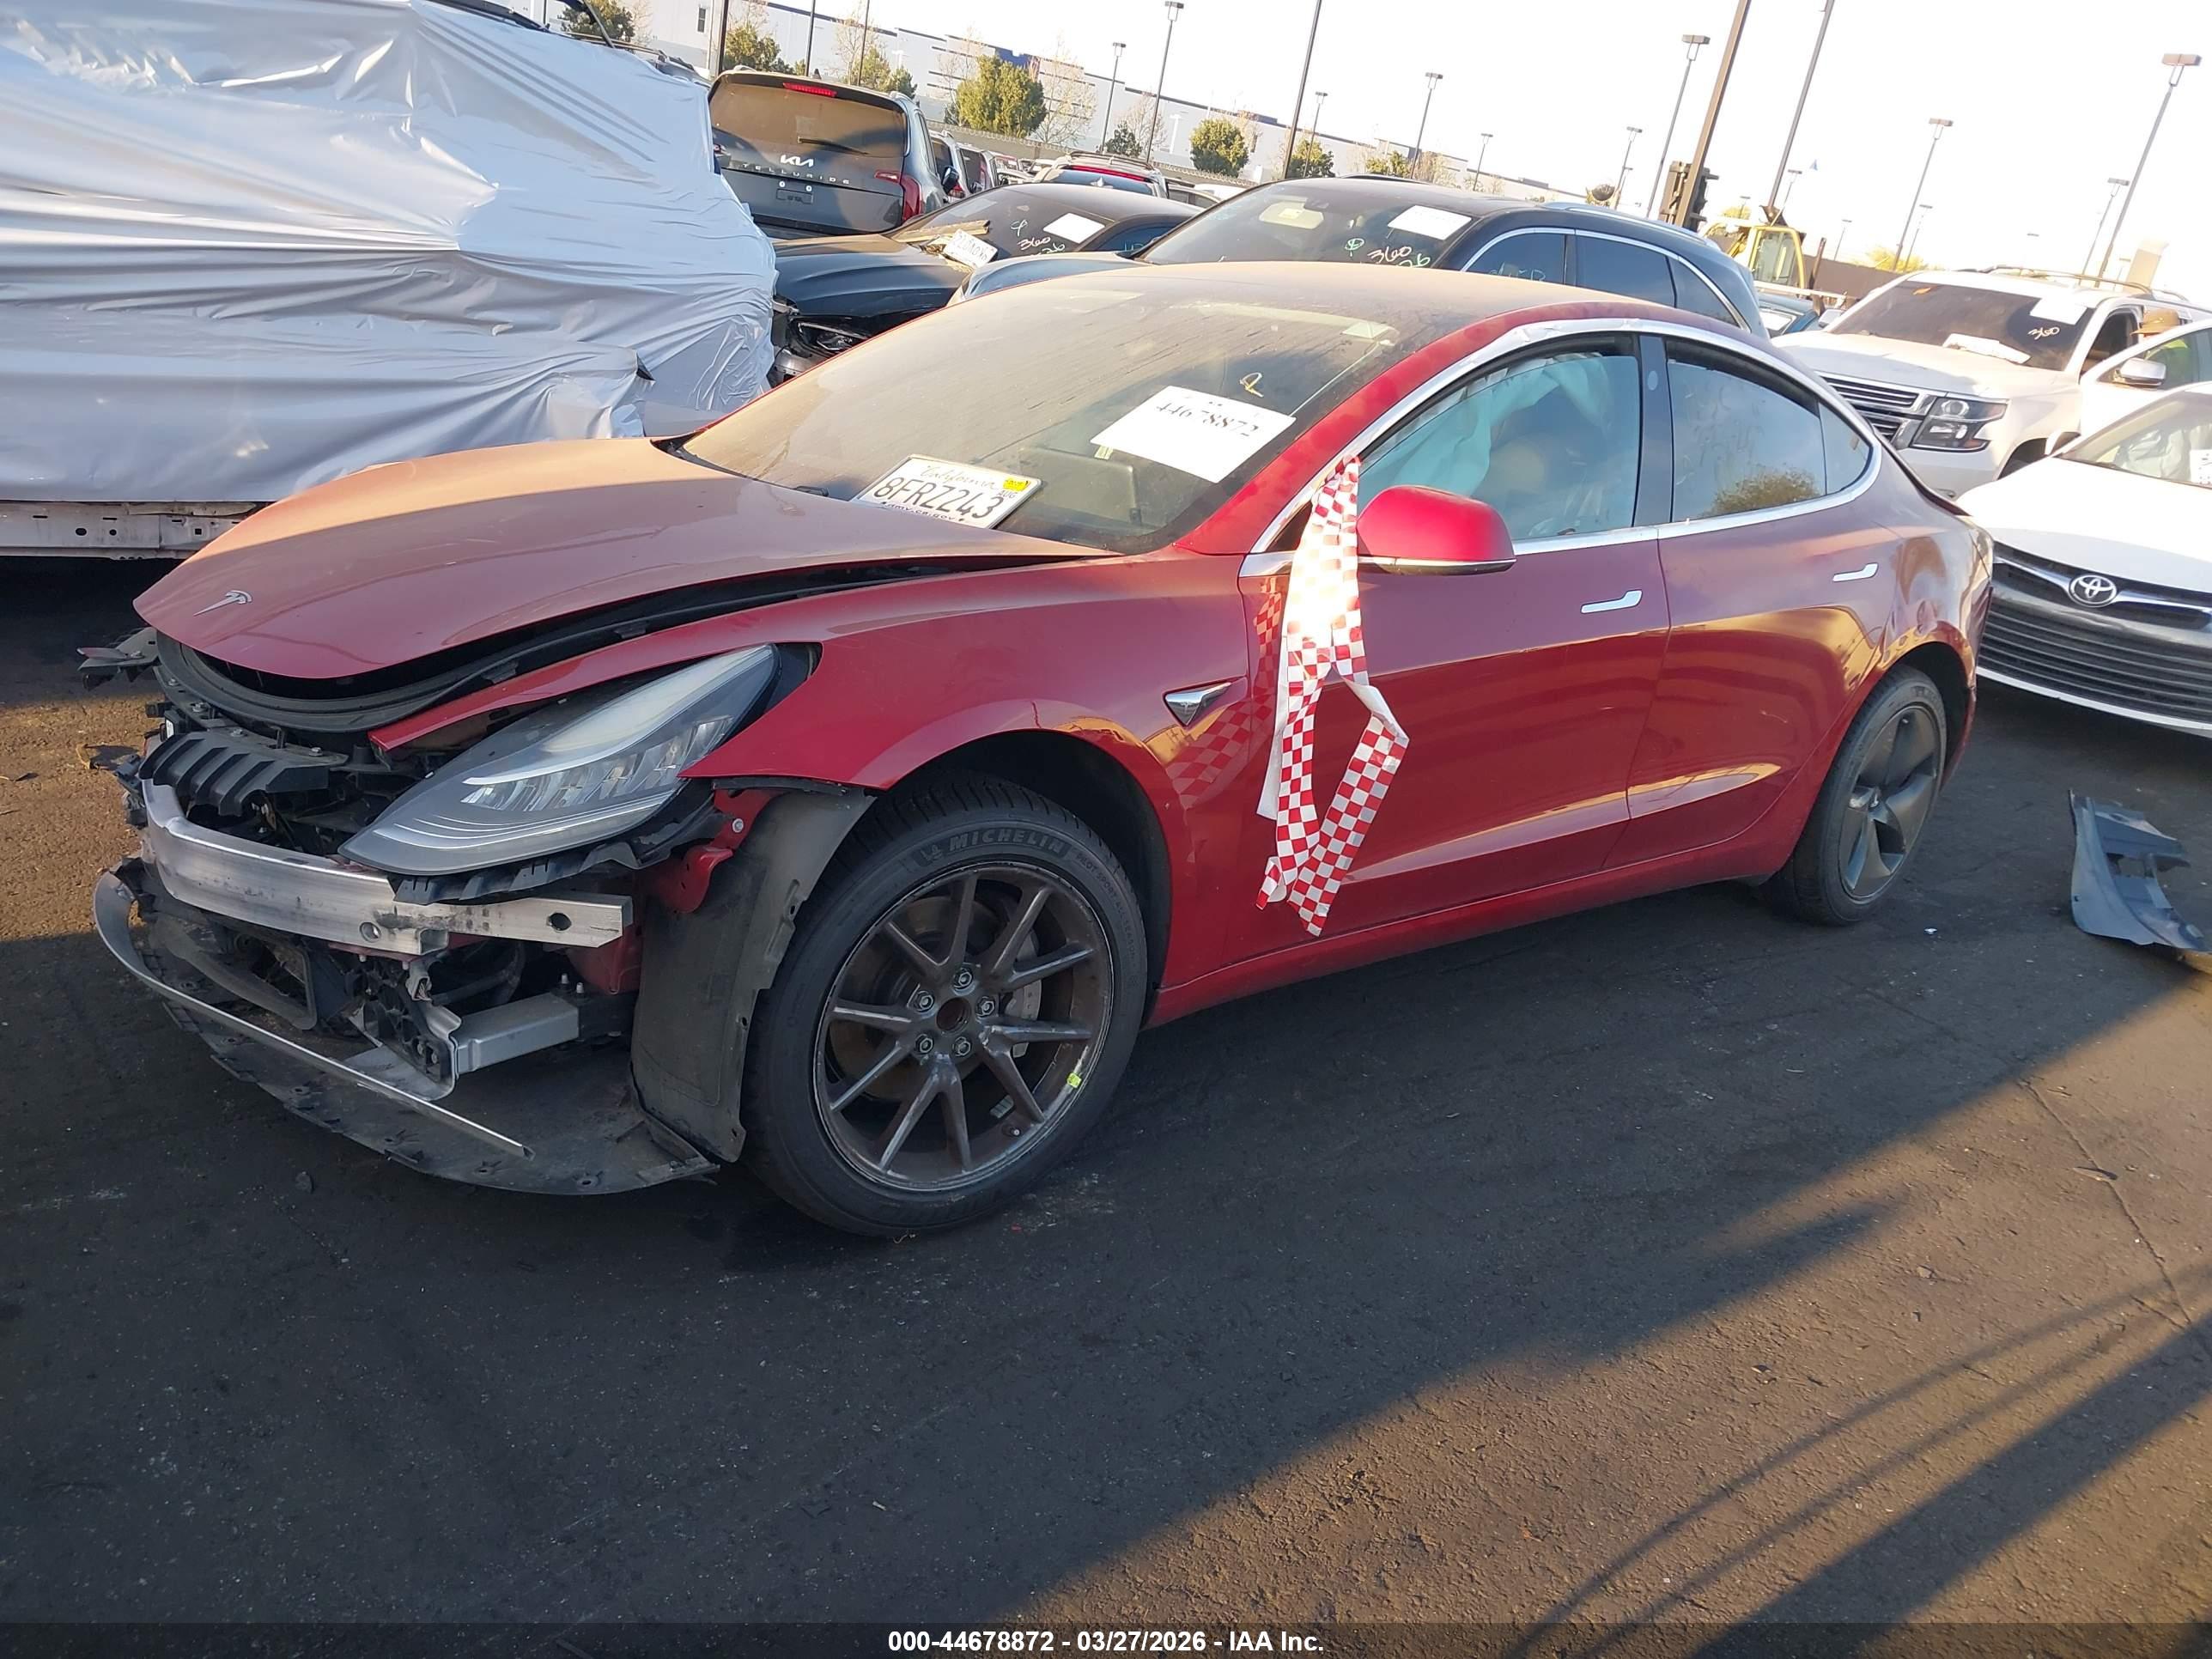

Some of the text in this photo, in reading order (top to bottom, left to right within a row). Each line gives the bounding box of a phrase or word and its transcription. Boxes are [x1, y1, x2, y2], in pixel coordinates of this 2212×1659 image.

[743, 163, 850, 185] TELLURIDE
[873, 477, 1004, 520] 8FRZ243
[948, 828, 1065, 854] MICHELIN
